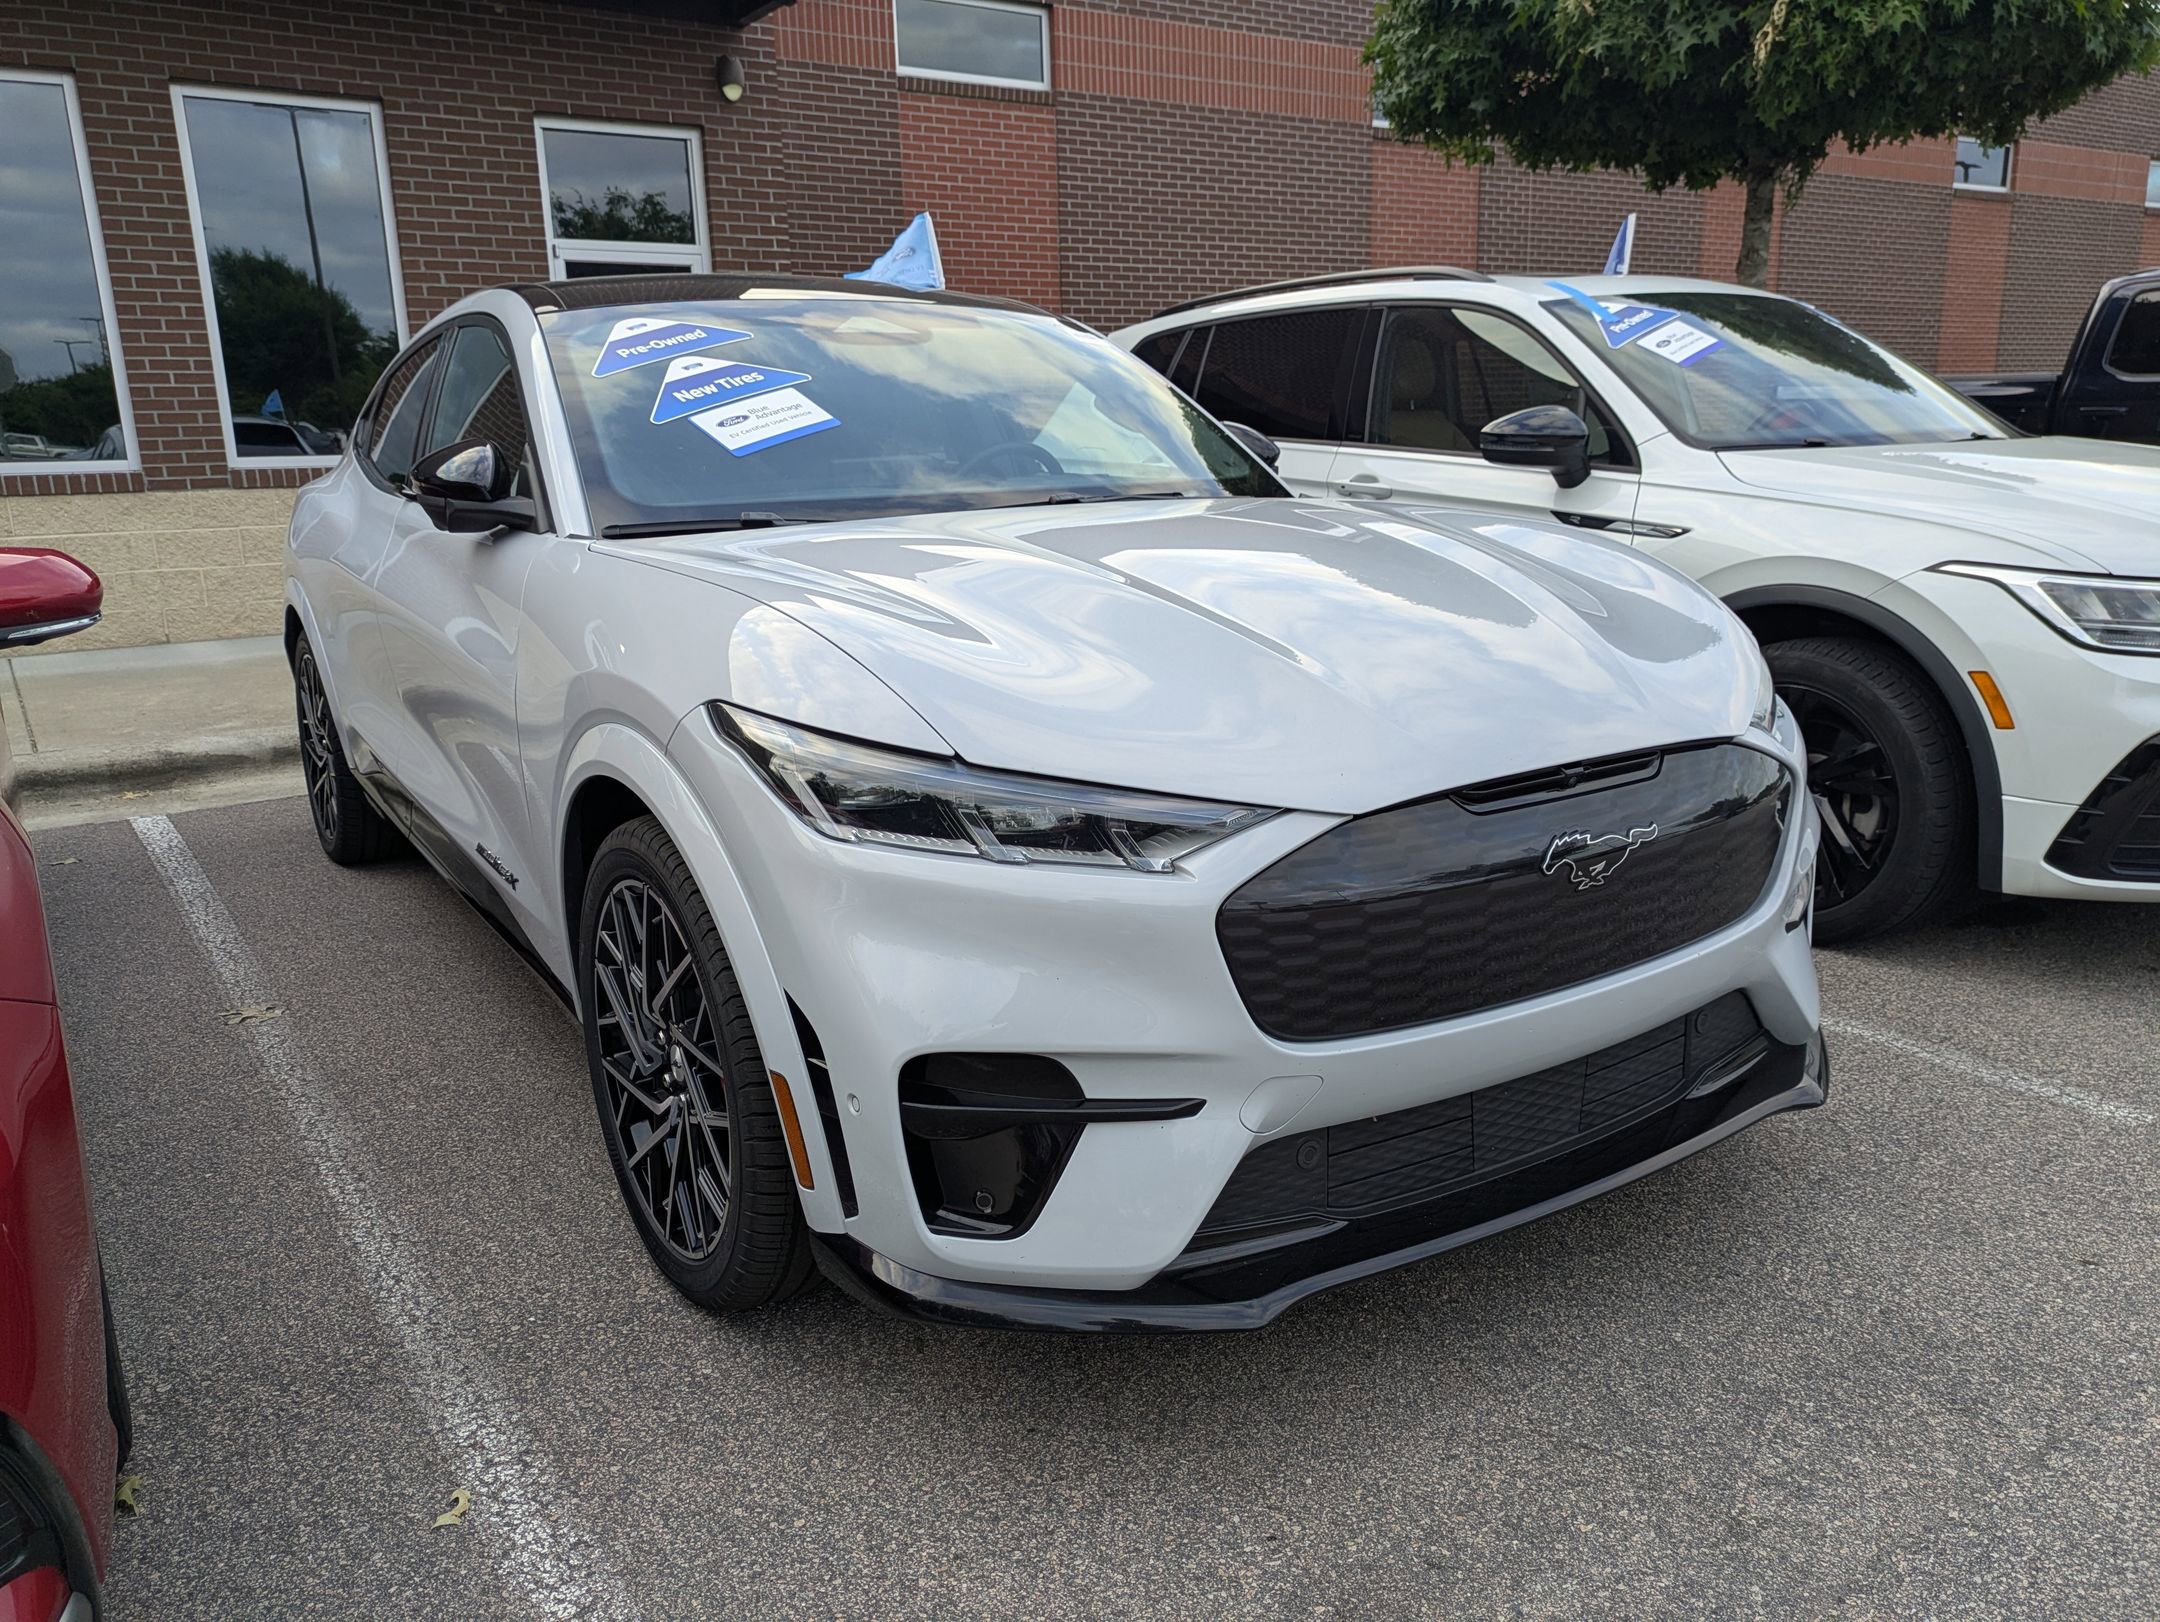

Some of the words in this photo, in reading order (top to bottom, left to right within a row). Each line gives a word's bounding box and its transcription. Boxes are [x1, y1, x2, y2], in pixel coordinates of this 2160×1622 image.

[616, 328, 708, 358] Pre-Owned
[672, 385, 719, 403] New
[713, 371, 765, 389] Tires
[740, 423, 771, 435] Certified
[770, 417, 788, 426] Used
[788, 410, 812, 420] Vehicle
[747, 405, 770, 415] Blue
[754, 402, 803, 421] Advantage
